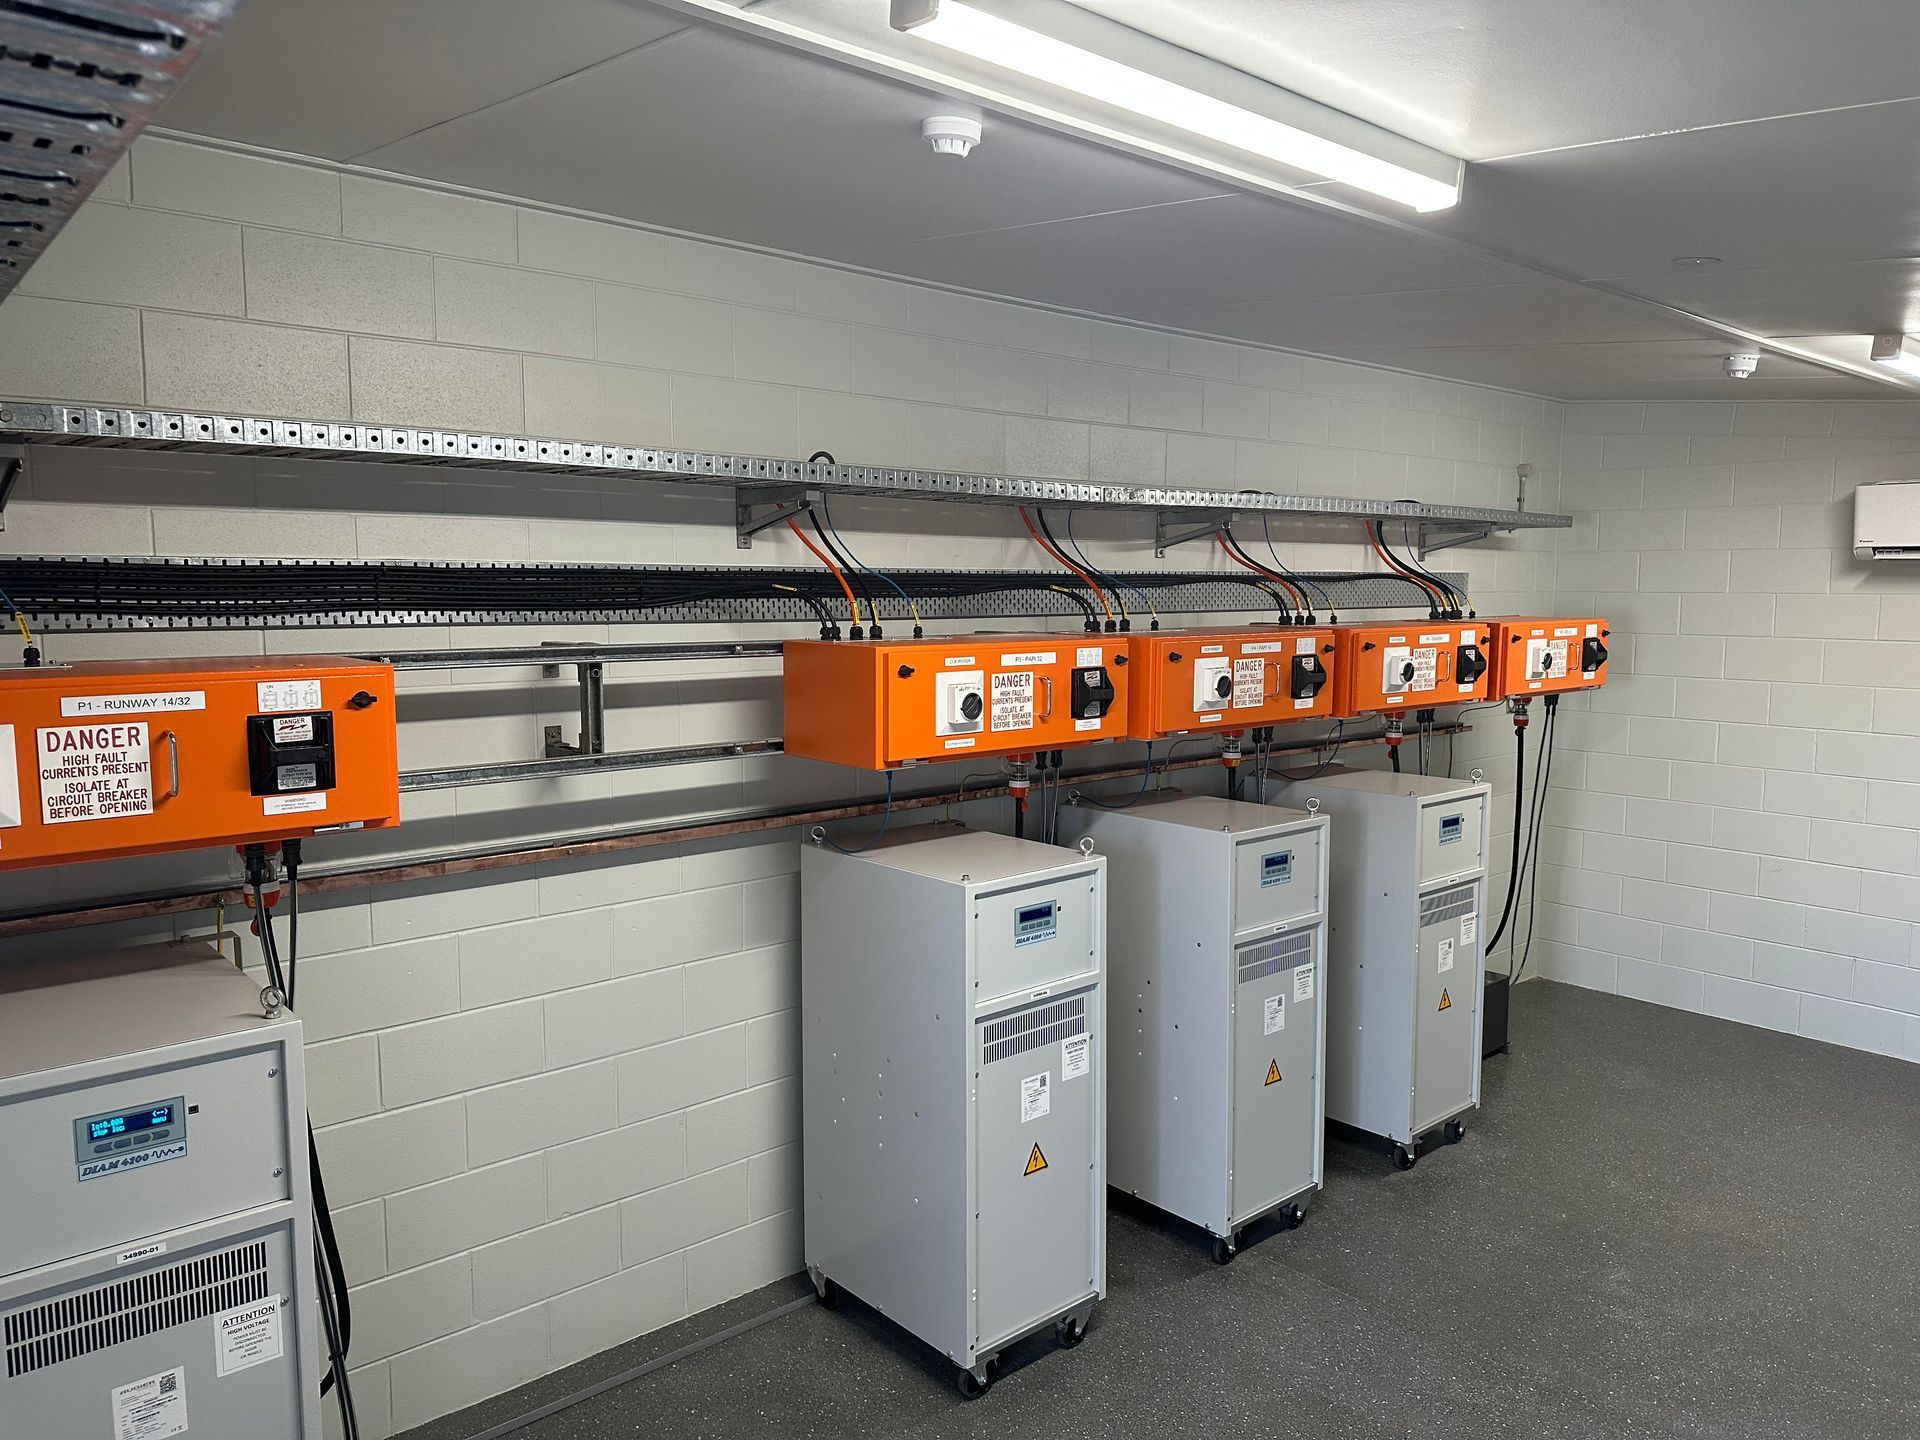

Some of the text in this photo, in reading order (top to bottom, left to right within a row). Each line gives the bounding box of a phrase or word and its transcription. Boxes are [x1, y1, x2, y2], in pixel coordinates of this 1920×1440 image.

[1236, 660, 1262, 672] DANGER
[994, 674, 1031, 689] DANGER
[78, 701, 92, 711] P1
[104, 698, 158, 710] RUNWAY
[161, 696, 191, 706] 14/32
[992, 696, 1032, 705] CURRENTS PRESENT
[993, 712, 1031, 722] CIRCUIT BREAKER
[1000, 706, 1017, 714] ISOLATE
[279, 717, 306, 725] DANGER
[993, 719, 1031, 729] BEFORE OPENING
[46, 726, 141, 753] DANGER
[62, 751, 128, 767] HIGH FAULT
[42, 761, 149, 780] CURRENTS PRESENT
[64, 778, 129, 794] ISOLATE AT
[47, 788, 148, 807] CIRCUIT BREAKER
[49, 800, 147, 820] BEFORE OPENING
[82, 1159, 120, 1176] DIAM
[123, 1246, 159, 1261] 34990-01
[222, 1304, 275, 1328] ATTENTION
[227, 1318, 270, 1335] HIGH VOLTAGE
